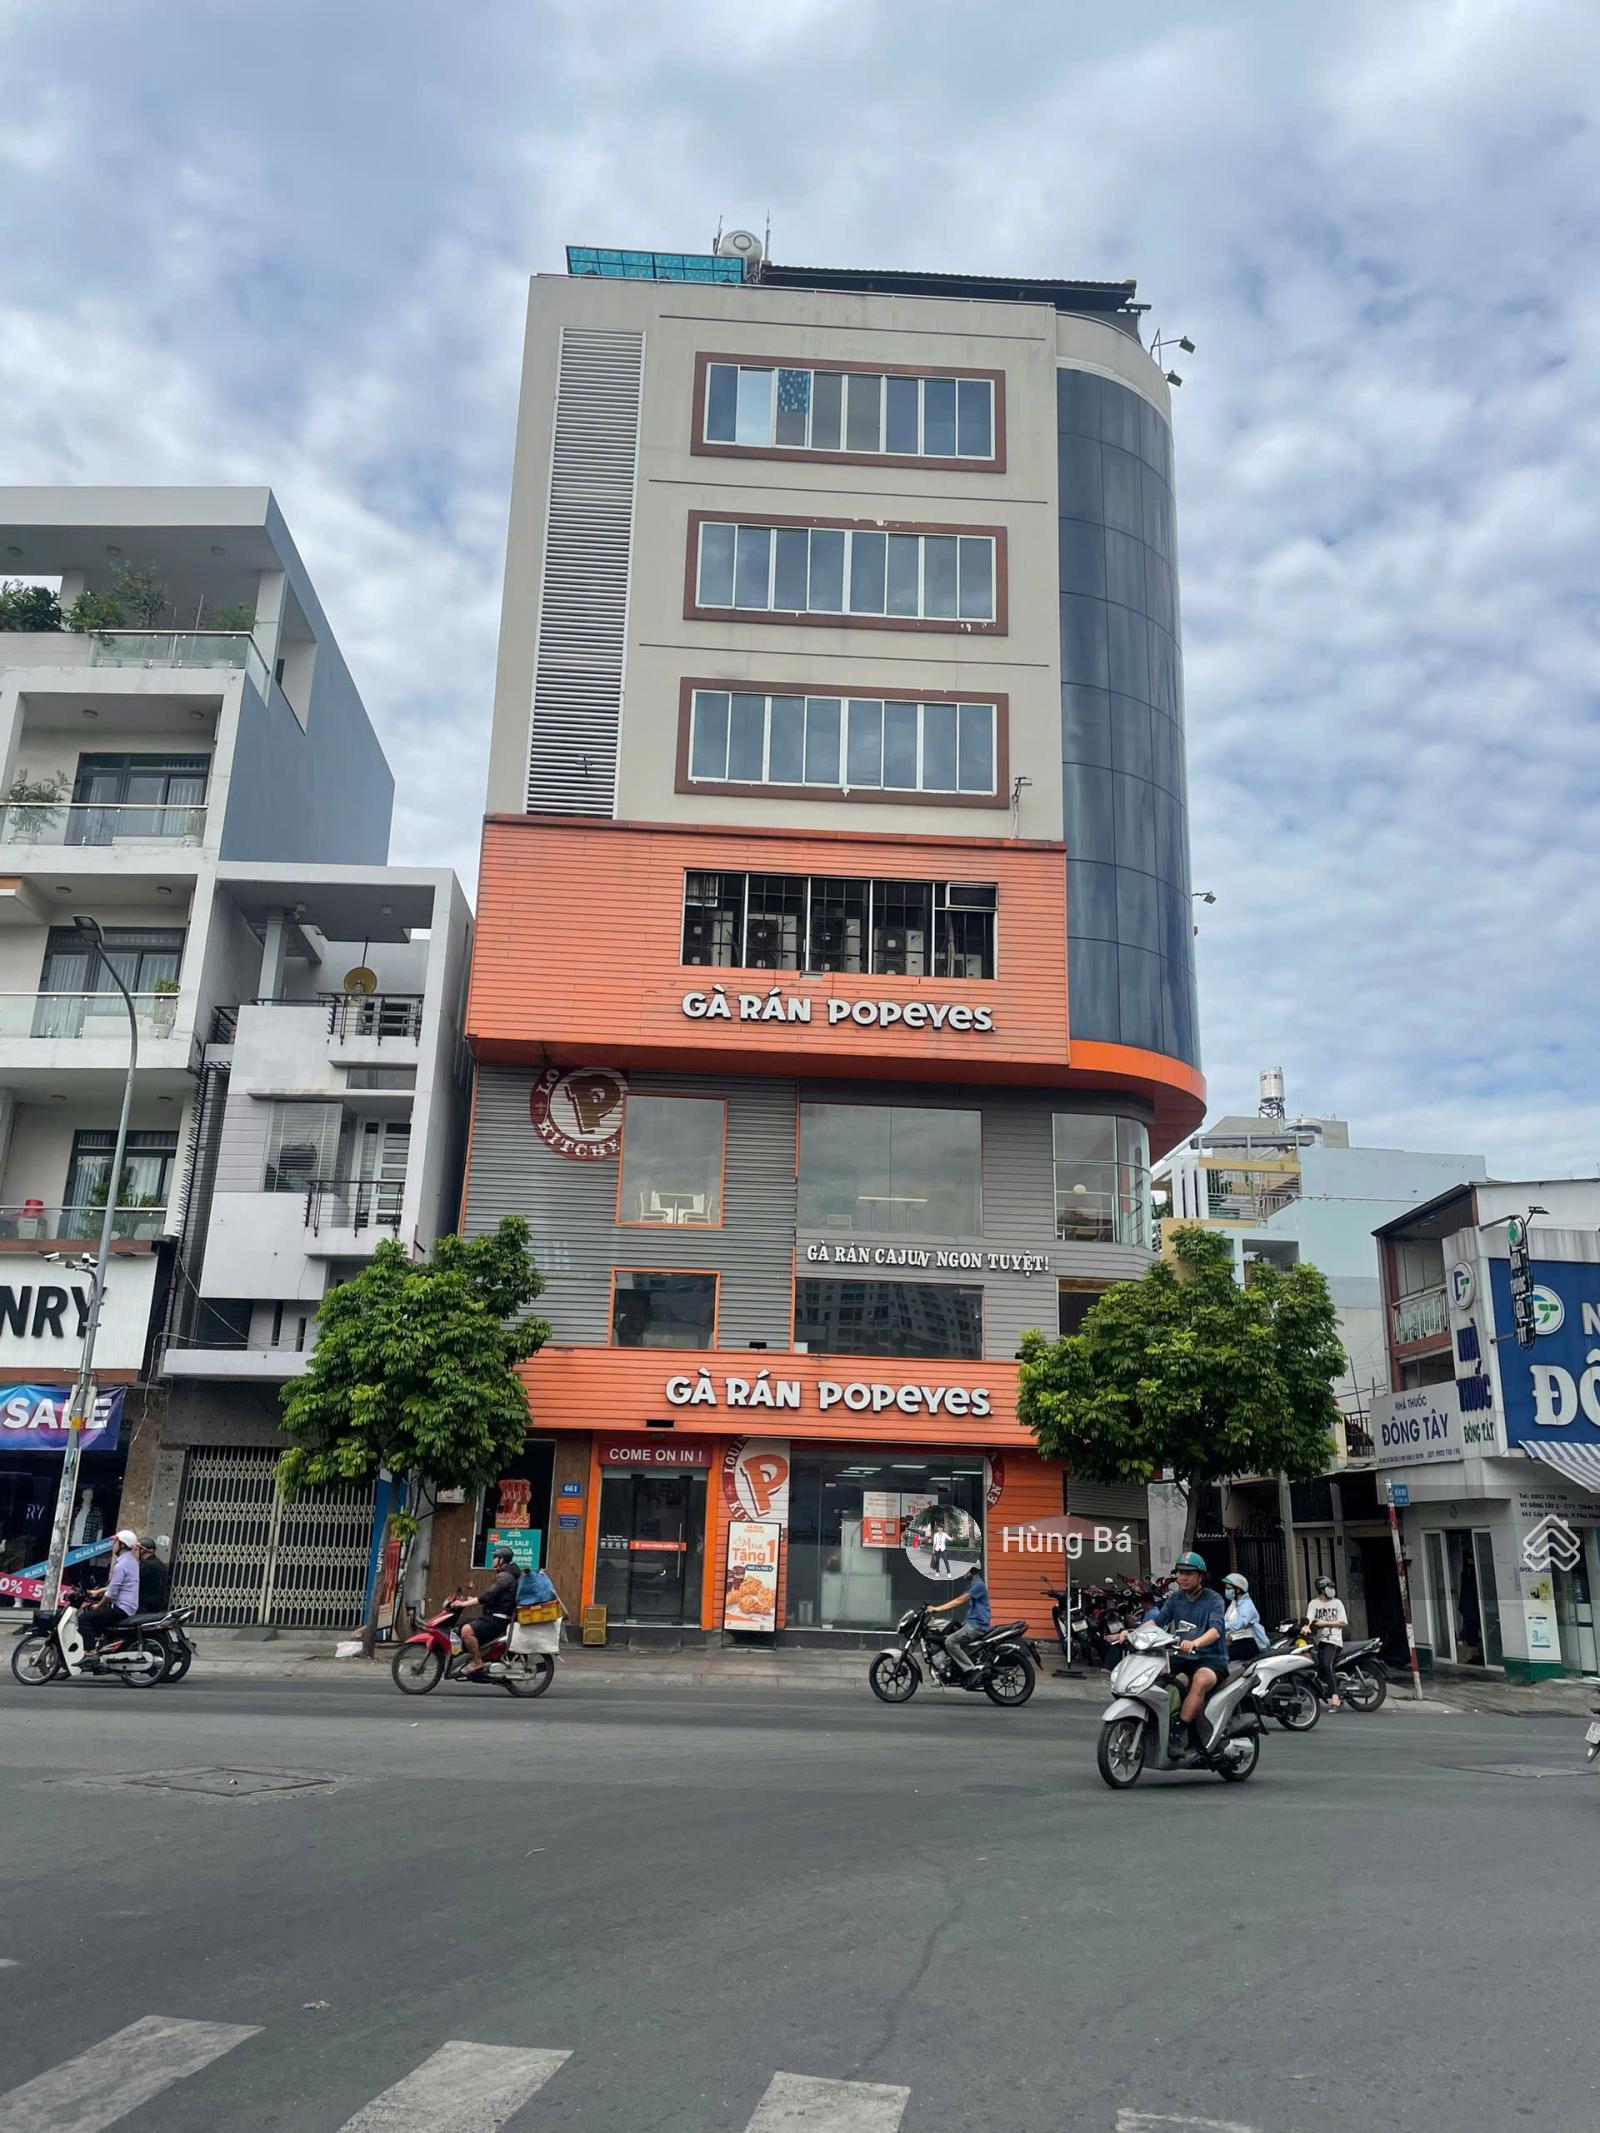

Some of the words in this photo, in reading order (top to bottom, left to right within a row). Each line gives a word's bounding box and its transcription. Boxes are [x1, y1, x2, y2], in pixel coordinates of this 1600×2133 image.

[682, 983, 732, 1019] GÀ
[738, 986, 811, 1022] RÁN
[807, 1240, 830, 1262] GÀ
[834, 1242, 870, 1264] RÁN
[874, 1248, 931, 1268] CAJUN
[936, 1251, 983, 1269] NGON
[988, 1250, 1049, 1277] TUYỆT!
[666, 1367, 717, 1405] GÀ
[725, 1368, 800, 1409] RÁN
[1382, 1416, 1420, 1446] ĐÔNG
[1423, 1408, 1448, 1440] TÂY
[609, 1448, 651, 1460] COME
[655, 1450, 676, 1461] ON
[680, 1450, 694, 1461] IN
[732, 1547, 766, 1564] Tặng
[767, 1540, 775, 1563] 1
